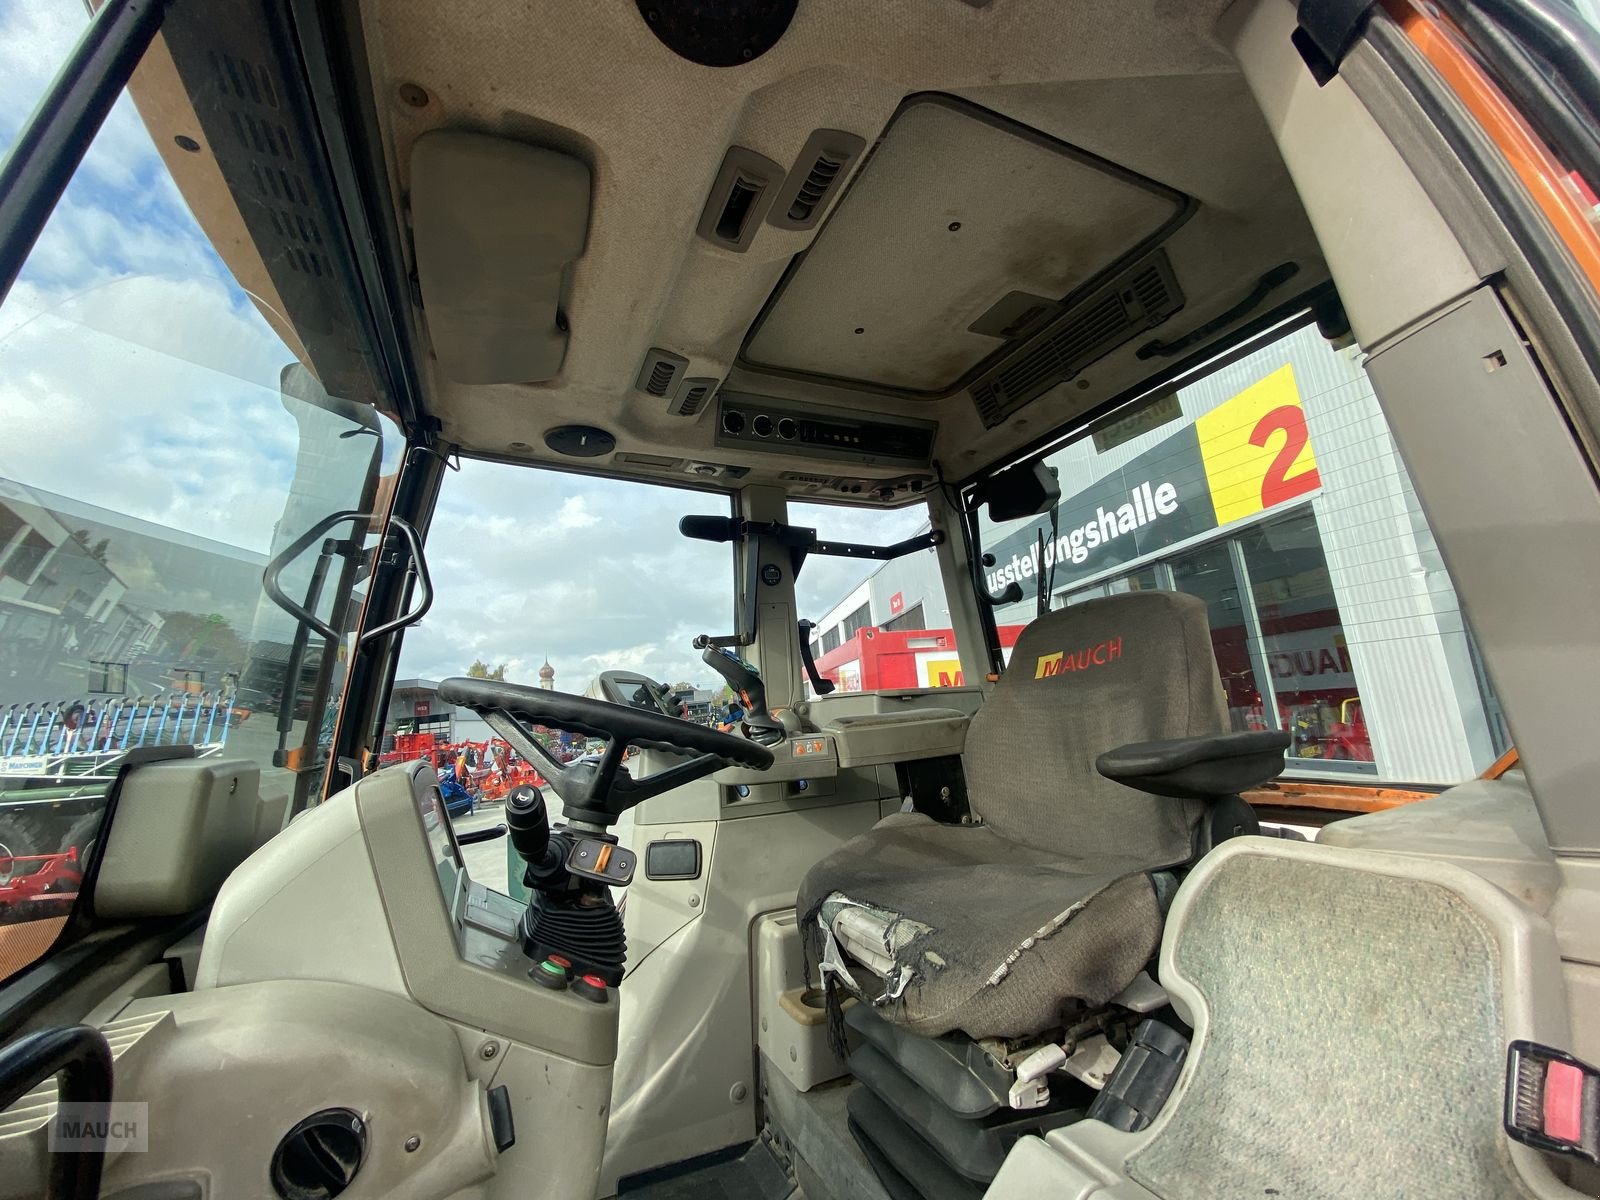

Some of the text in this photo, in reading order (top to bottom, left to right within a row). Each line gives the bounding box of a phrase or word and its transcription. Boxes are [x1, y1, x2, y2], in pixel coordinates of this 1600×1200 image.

[987, 404, 1322, 594] usstelungshalle 2
[1042, 637, 1122, 677] MAUCH
